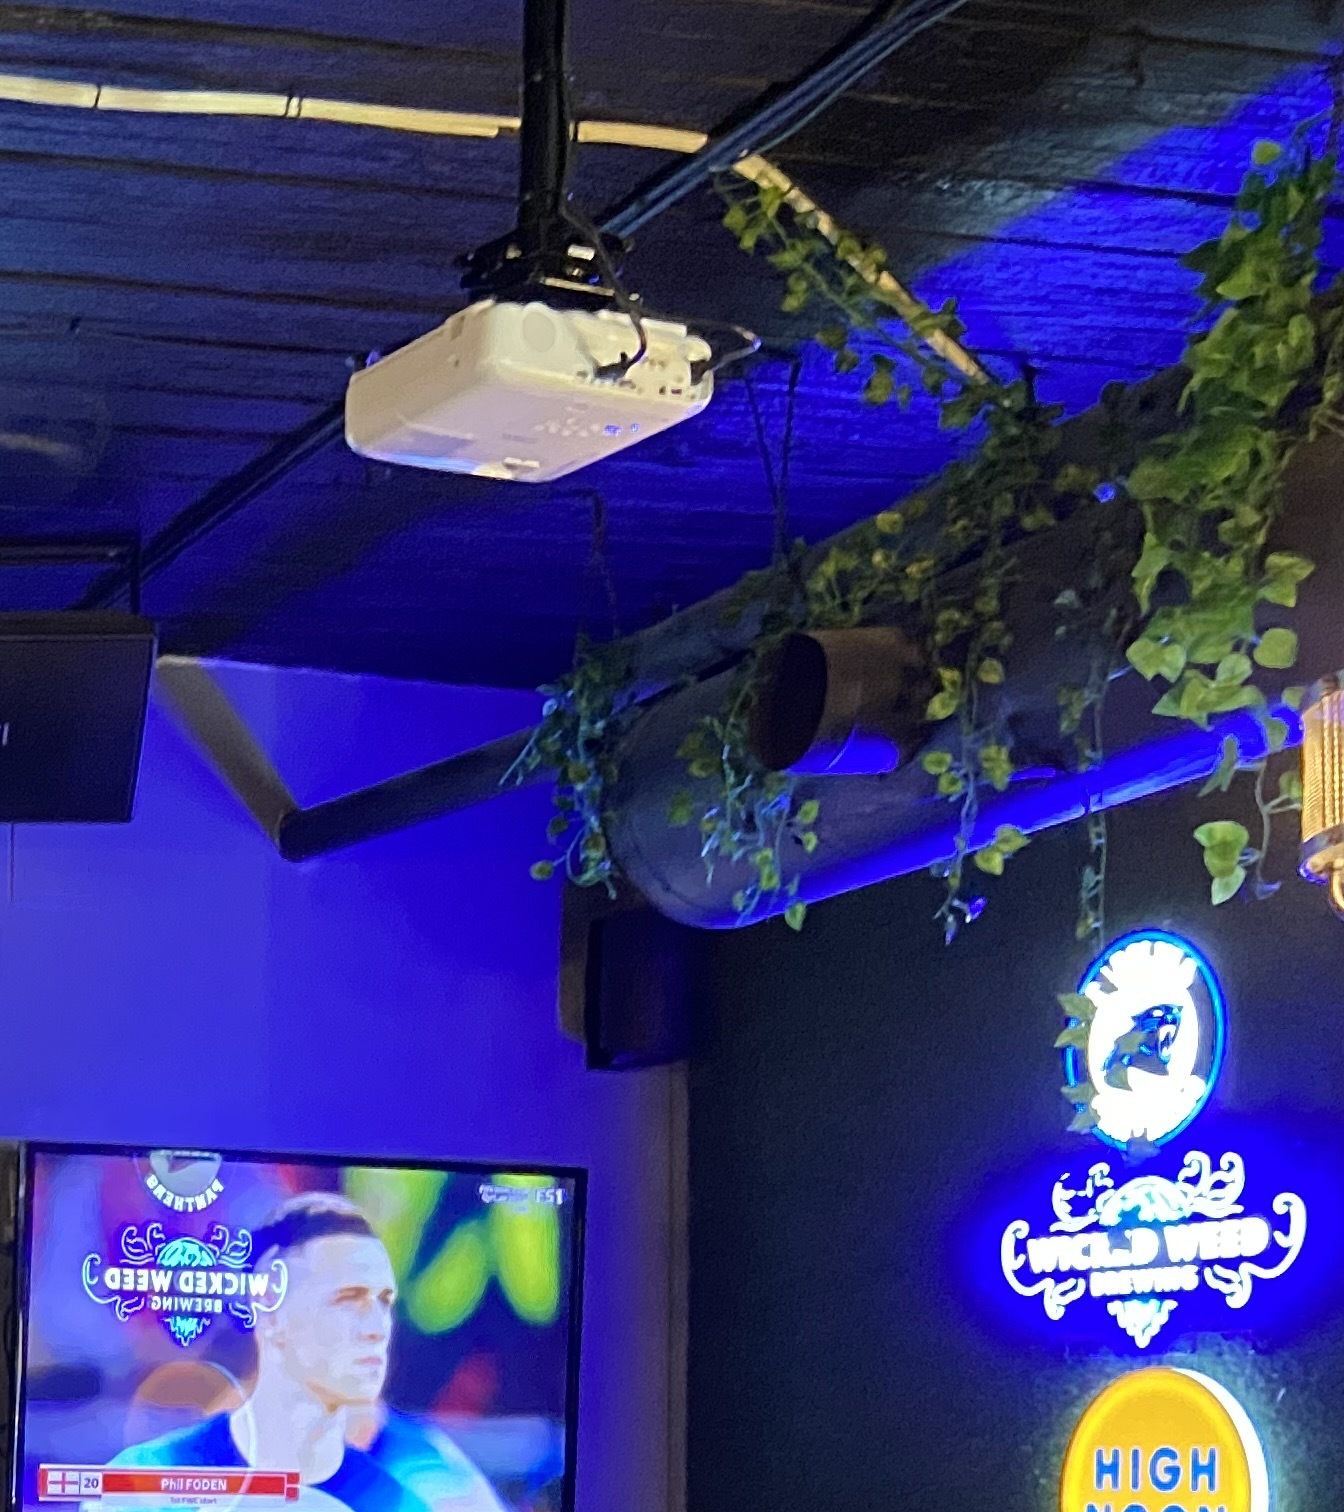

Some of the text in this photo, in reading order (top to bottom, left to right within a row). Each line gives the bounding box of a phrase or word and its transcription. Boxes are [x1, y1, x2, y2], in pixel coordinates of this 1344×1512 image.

[535, 1187, 564, 1206] FS1
[1094, 1446, 1218, 1492] HIGH
[83, 1477, 100, 1490] 20
[160, 1478, 228, 1492] Phil FODEN
